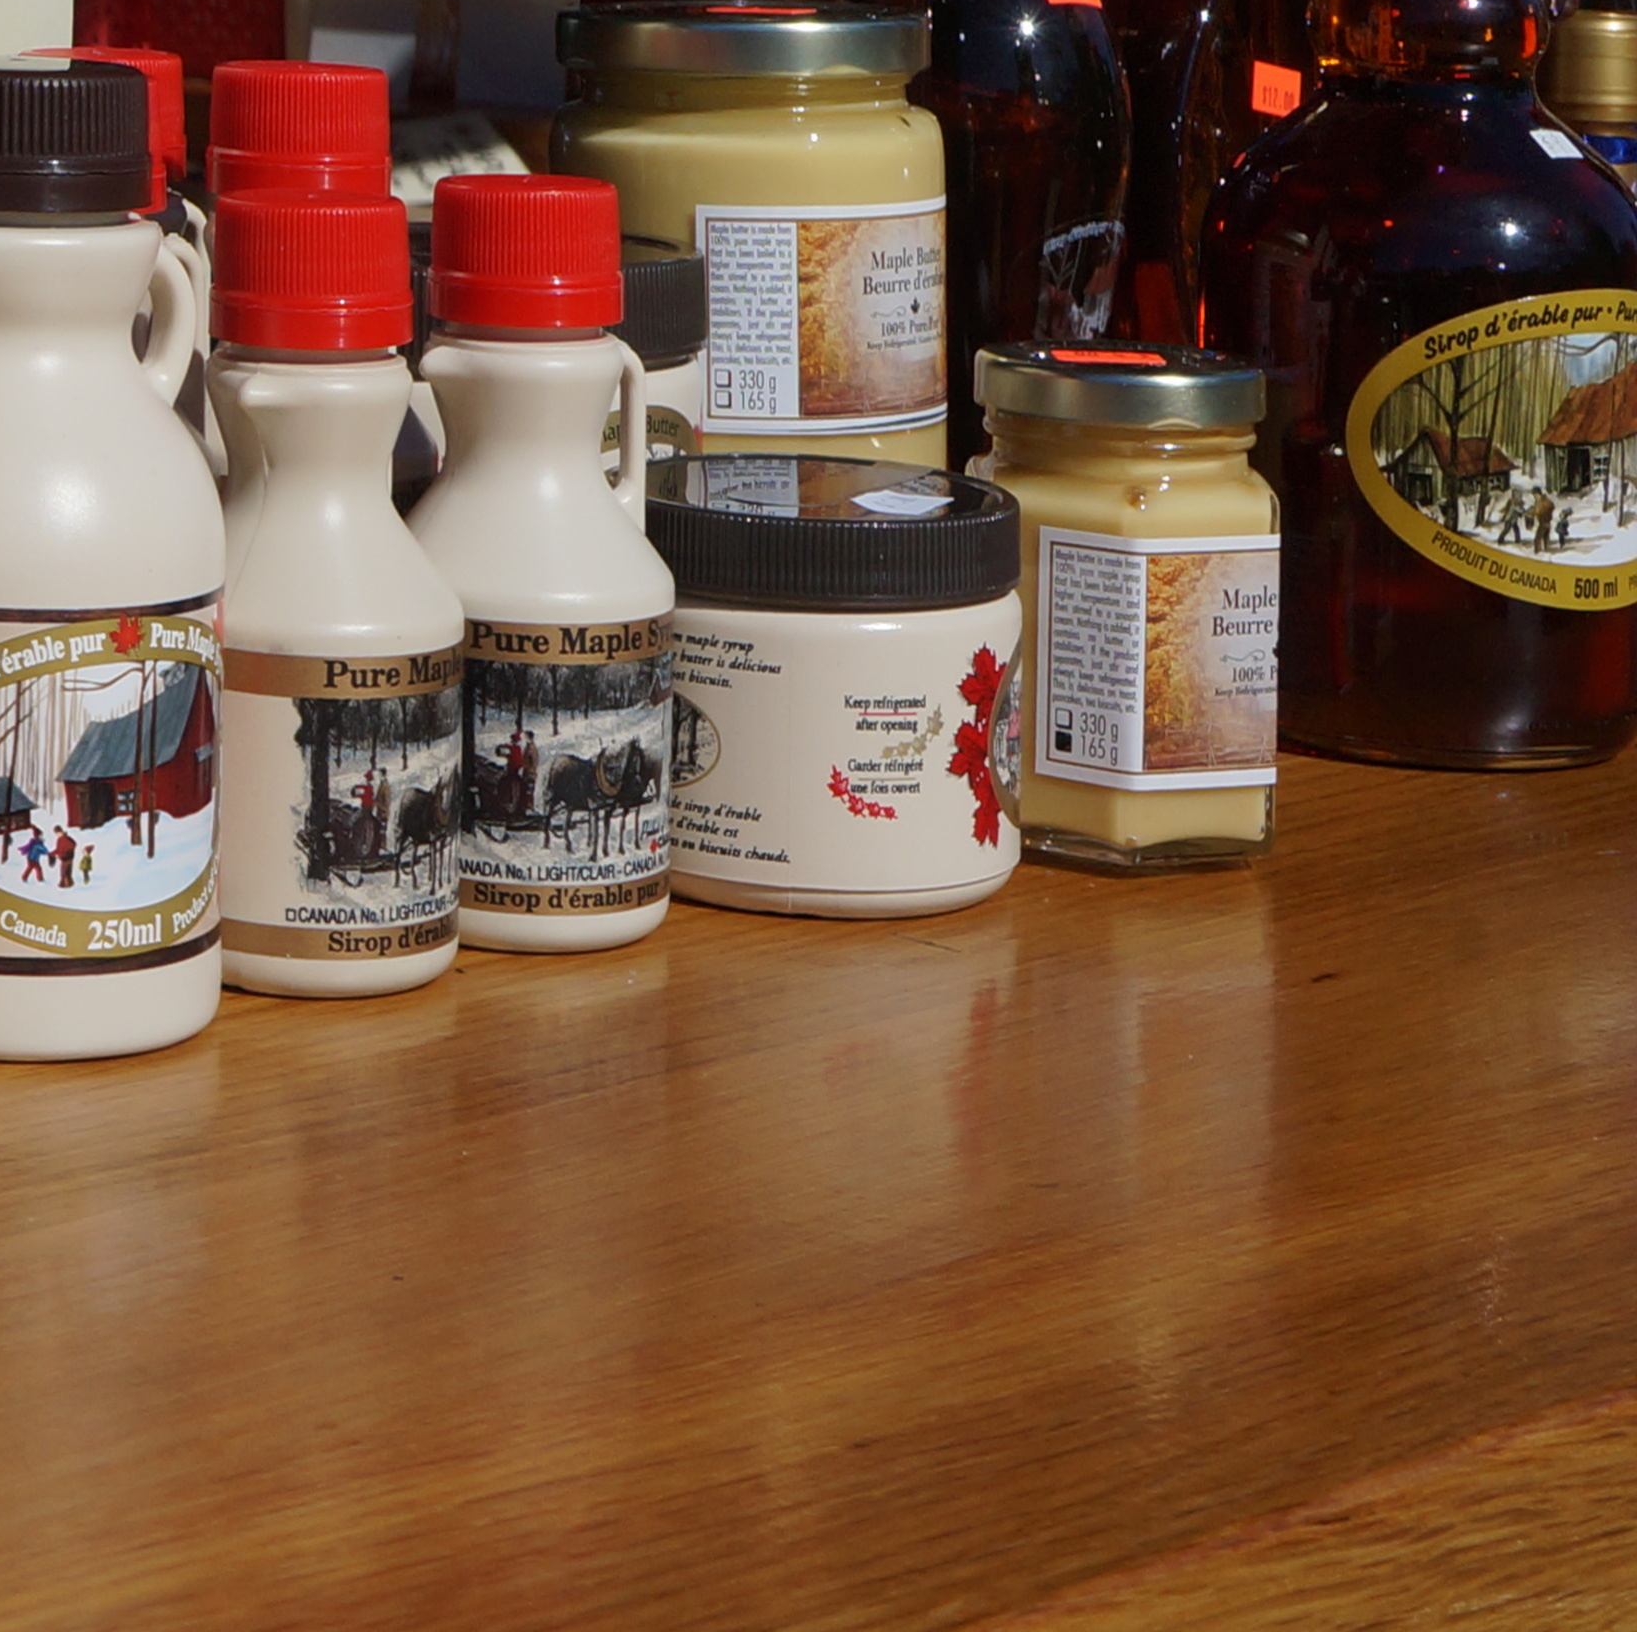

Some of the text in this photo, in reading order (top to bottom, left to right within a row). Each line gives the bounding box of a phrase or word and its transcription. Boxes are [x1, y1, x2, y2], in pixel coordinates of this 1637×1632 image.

[871, 247, 913, 274] Maple
[863, 275, 911, 296] Beurre
[1424, 325, 1479, 359] Sirop
[1571, 306, 1603, 329] pur
[739, 369, 776, 394] 330 g
[739, 390, 776, 414] 165 g
[1431, 530, 1618, 599] PRODUIT DU CANADA 500 ml
[1222, 585, 1277, 614] Maple
[1212, 615, 1273, 637] Beurre
[69, 631, 106, 662] pur
[149, 622, 185, 650] Pure
[469, 621, 550, 655] Pure
[559, 621, 642, 660] Maple
[686, 634, 719, 650] maple
[722, 639, 754, 656] syrup
[680, 649, 781, 674] butter delicious
[323, 659, 401, 689] Pure
[689, 669, 732, 689] biscuits.
[1231, 666, 1265, 683] 100%
[844, 694, 927, 713] Keep refrigerated
[856, 717, 918, 735] after opening
[1080, 713, 1118, 743] 330 g
[1080, 735, 1118, 766] 165 g
[847, 758, 882, 773] Garder
[685, 799, 762, 822] sirop d'érable
[699, 838, 741, 857] biscuits
[474, 881, 660, 912] Sirop d'érable pur
[298, 905, 357, 925] CANADA
[0, 909, 67, 948] Canada
[87, 914, 162, 951] 250ml
[328, 931, 392, 955] Sirop
